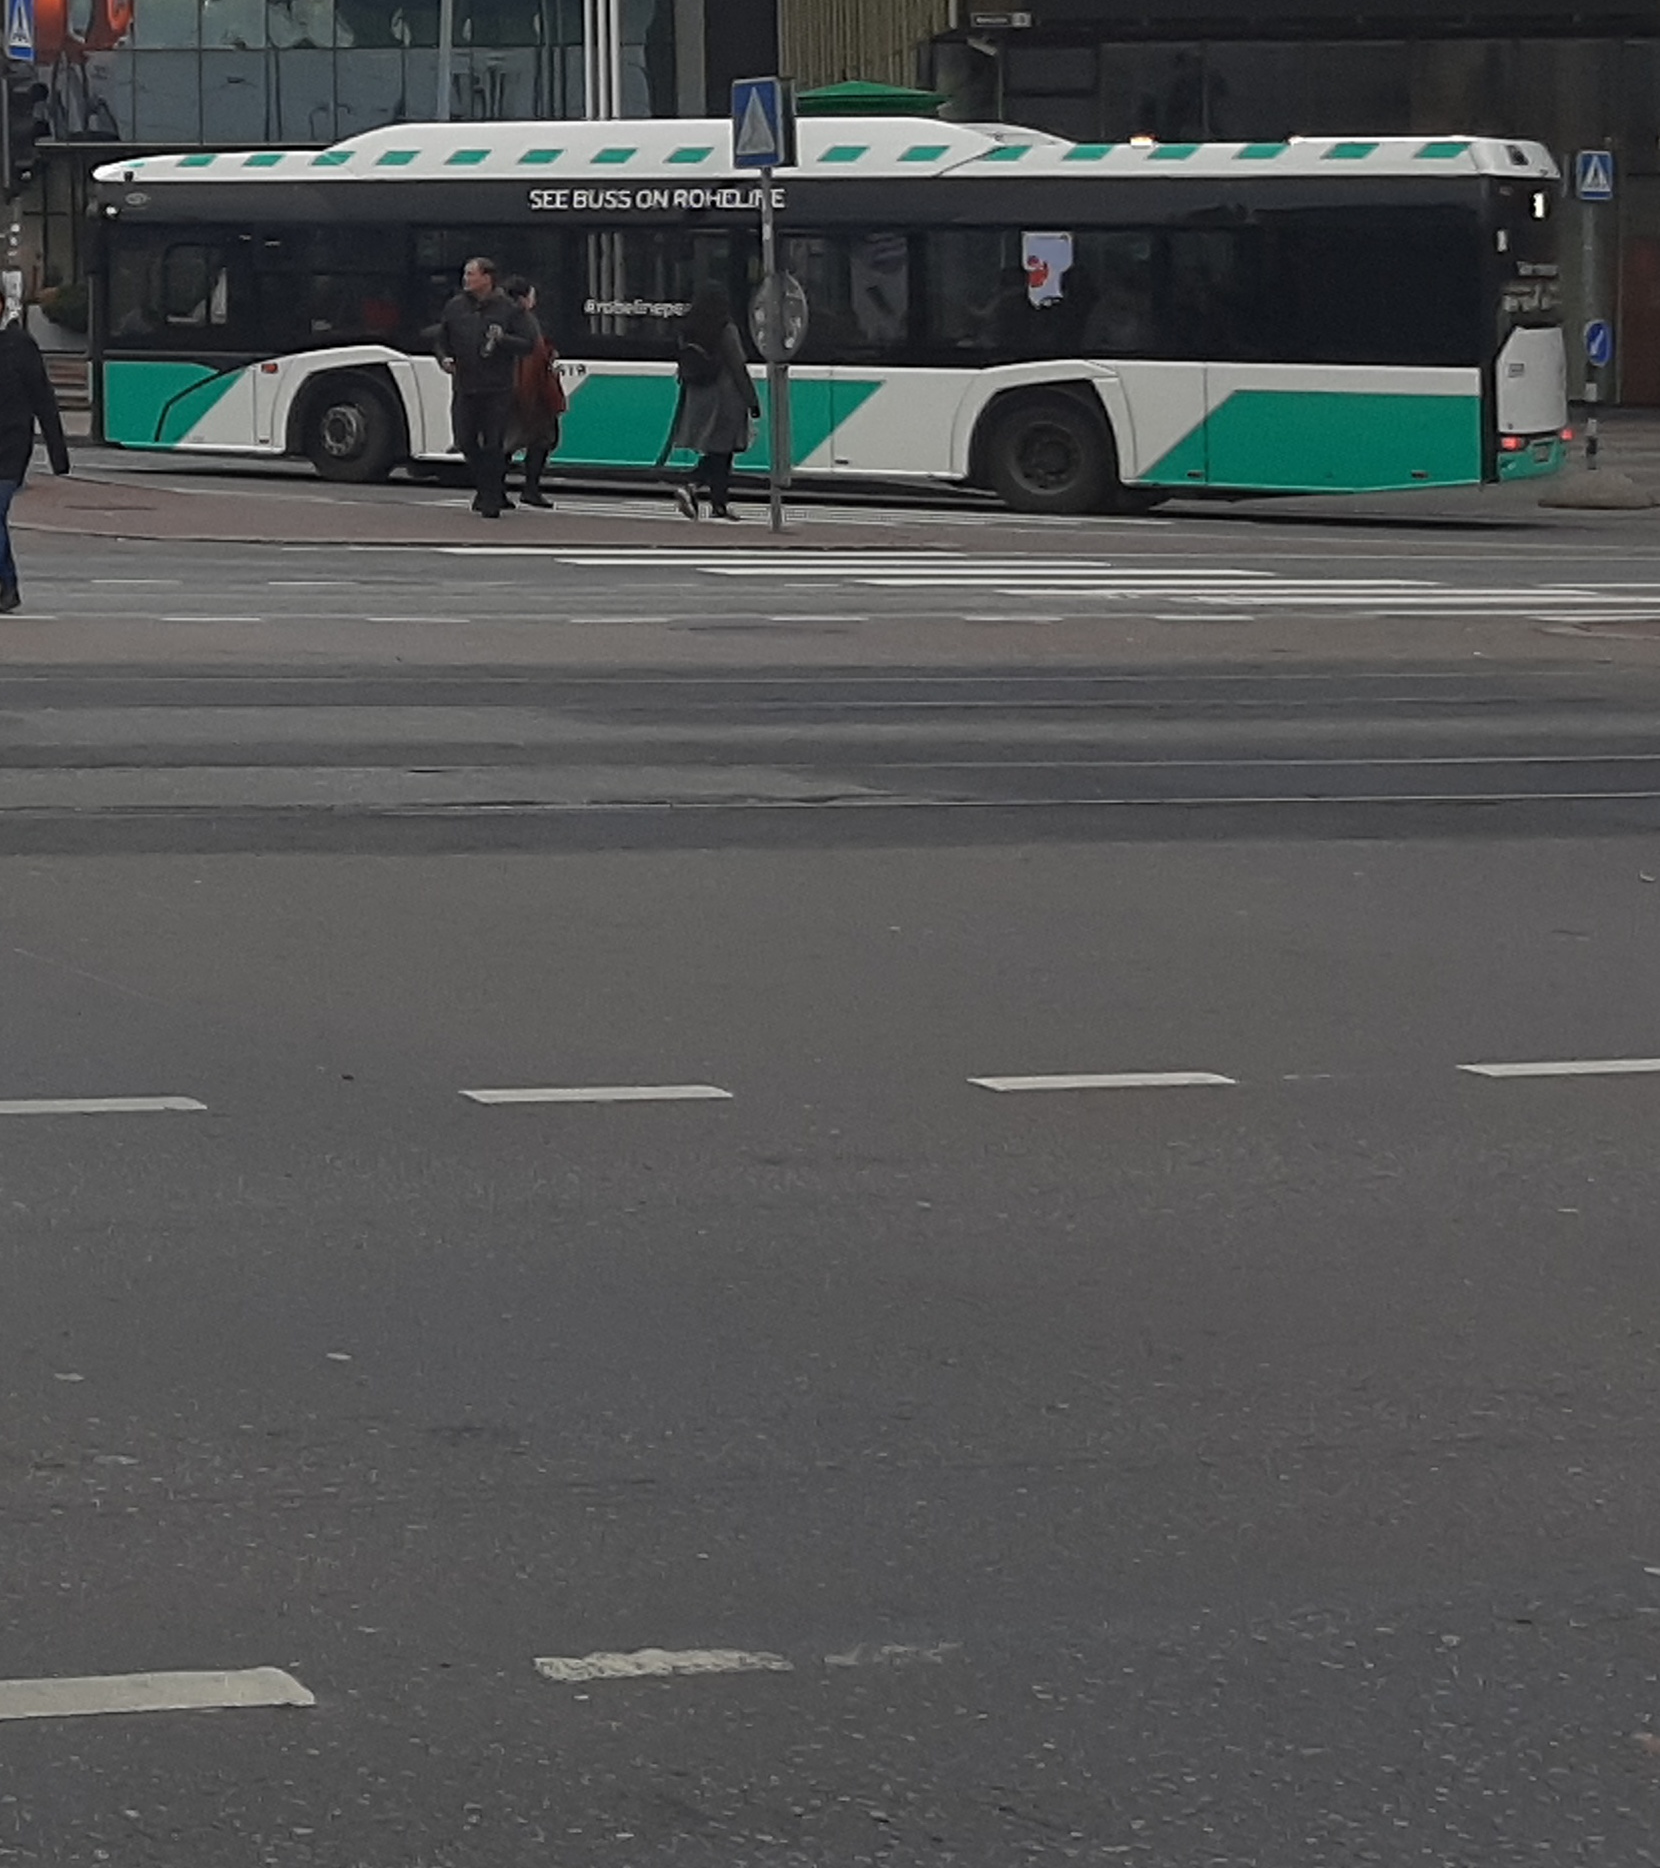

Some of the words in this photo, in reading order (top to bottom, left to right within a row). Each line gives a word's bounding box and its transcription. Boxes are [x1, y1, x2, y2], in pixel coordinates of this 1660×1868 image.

[530, 189, 569, 209] SEE
[573, 189, 631, 209] BUSS
[636, 189, 668, 209] ON
